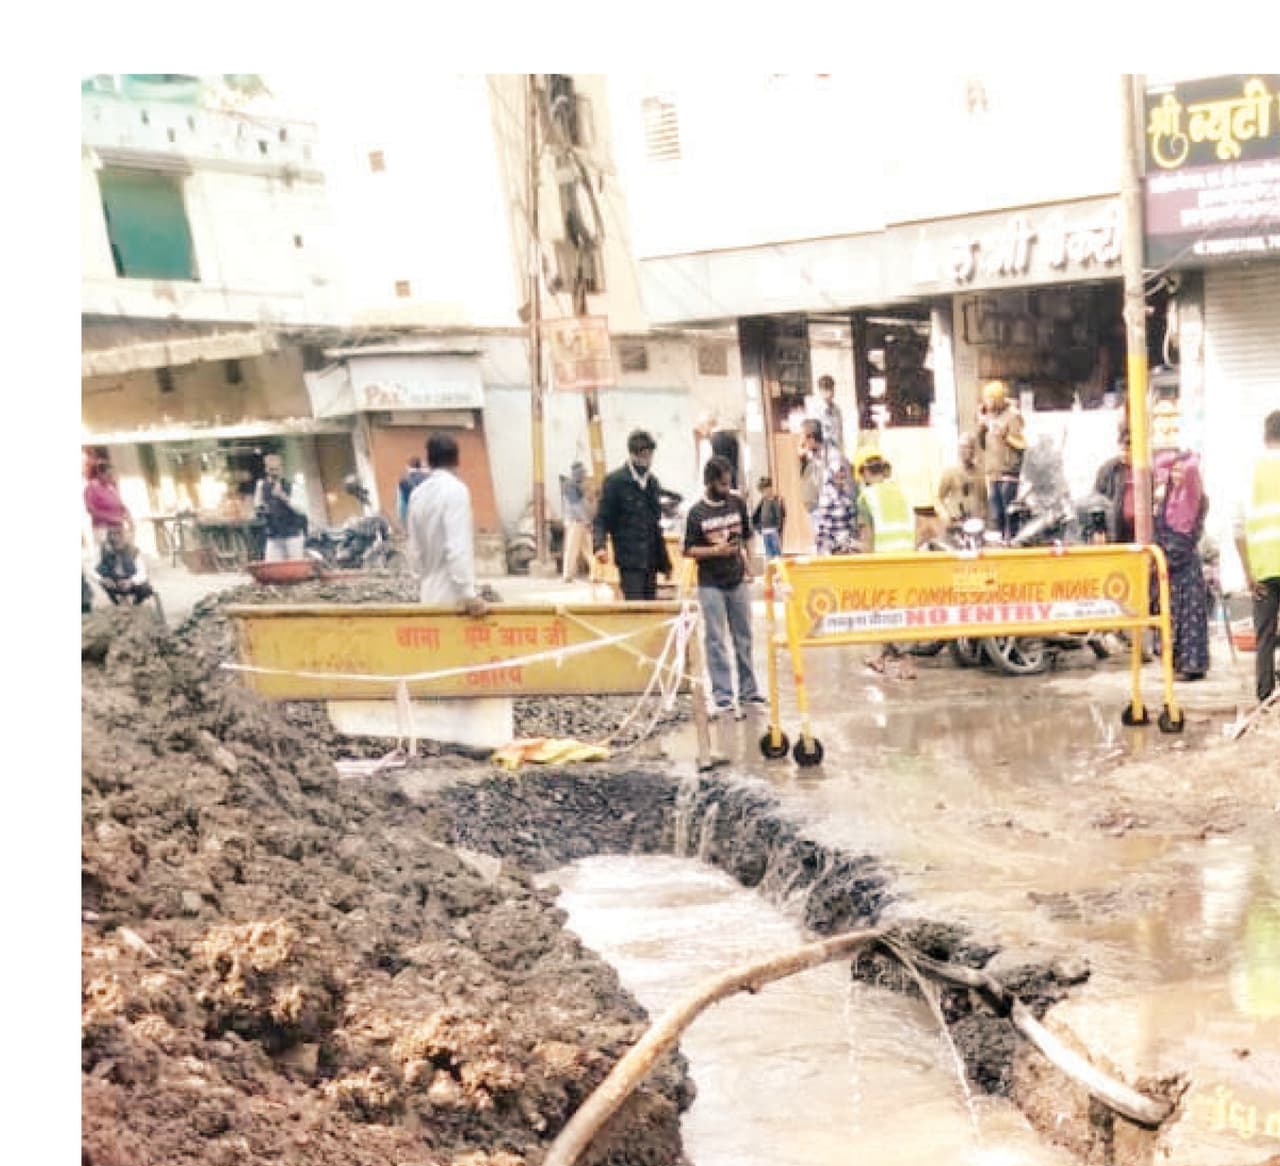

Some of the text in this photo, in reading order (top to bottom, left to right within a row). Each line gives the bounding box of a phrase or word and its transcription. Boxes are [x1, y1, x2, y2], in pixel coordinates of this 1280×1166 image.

[840, 586, 898, 609] POLICE
[905, 608, 949, 626] NO
[959, 603, 1052, 624] ENTRY
